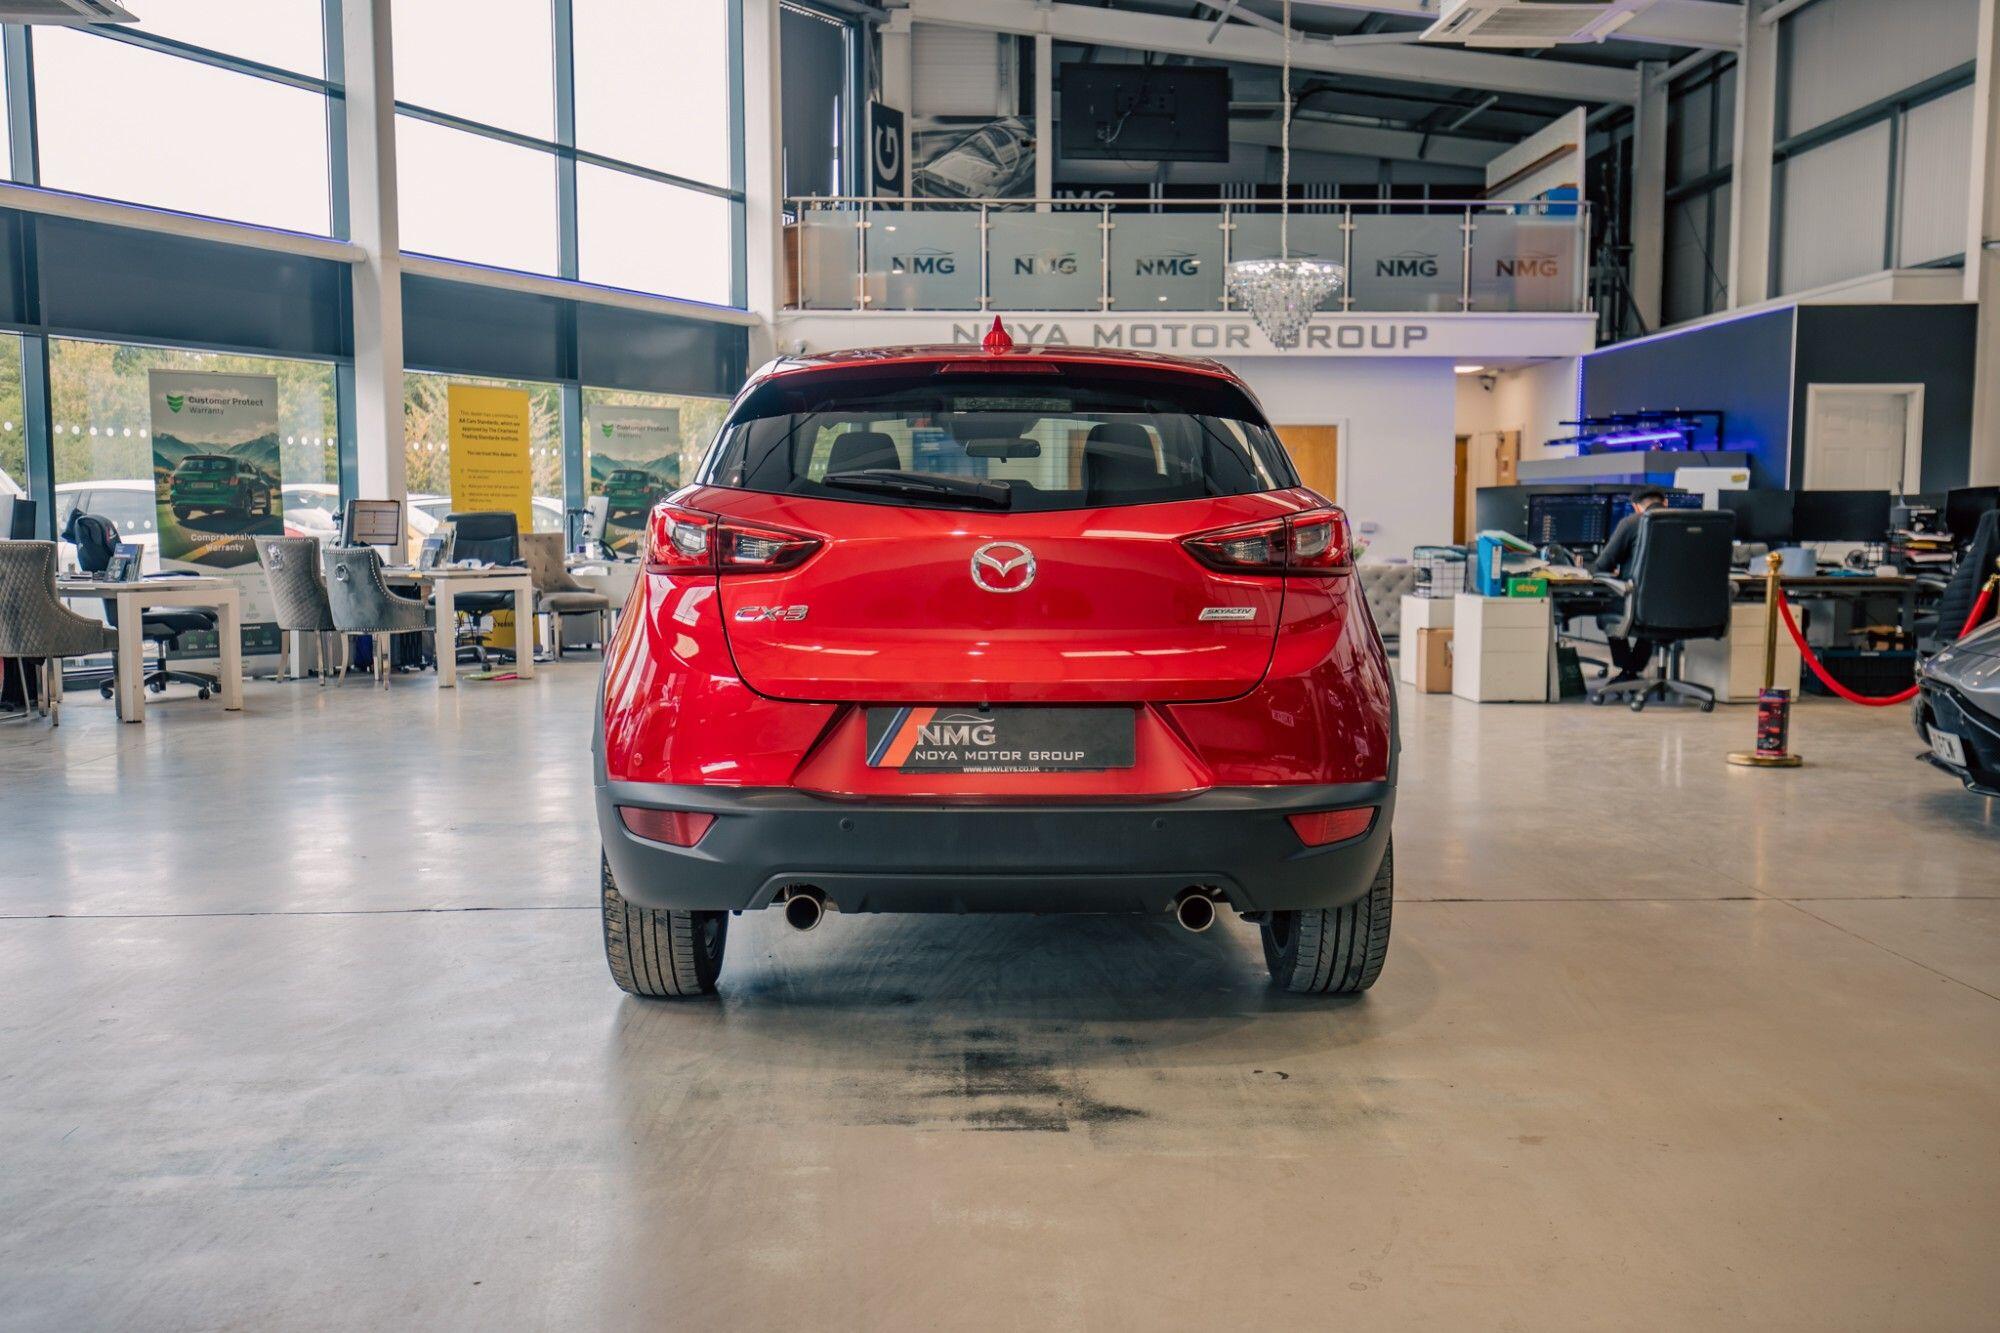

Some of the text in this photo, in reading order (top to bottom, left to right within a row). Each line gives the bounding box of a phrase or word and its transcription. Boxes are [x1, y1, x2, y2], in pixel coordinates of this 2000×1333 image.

[892, 257, 955, 274] NMG
[1136, 259, 1199, 276] NMG
[1376, 260, 1438, 277] NMG
[1496, 260, 1558, 277] NMG
[1094, 324, 1251, 348] MOTOR
[188, 396, 264, 407] Customer Protect
[189, 406, 225, 415] Warranty
[190, 533, 257, 542] Comprehensive
[205, 543, 244, 552] Warranty
[735, 604, 809, 622] CX-3
[917, 724, 996, 746] NMG
[915, 750, 1085, 761] NOYA MOTOR GROUP
